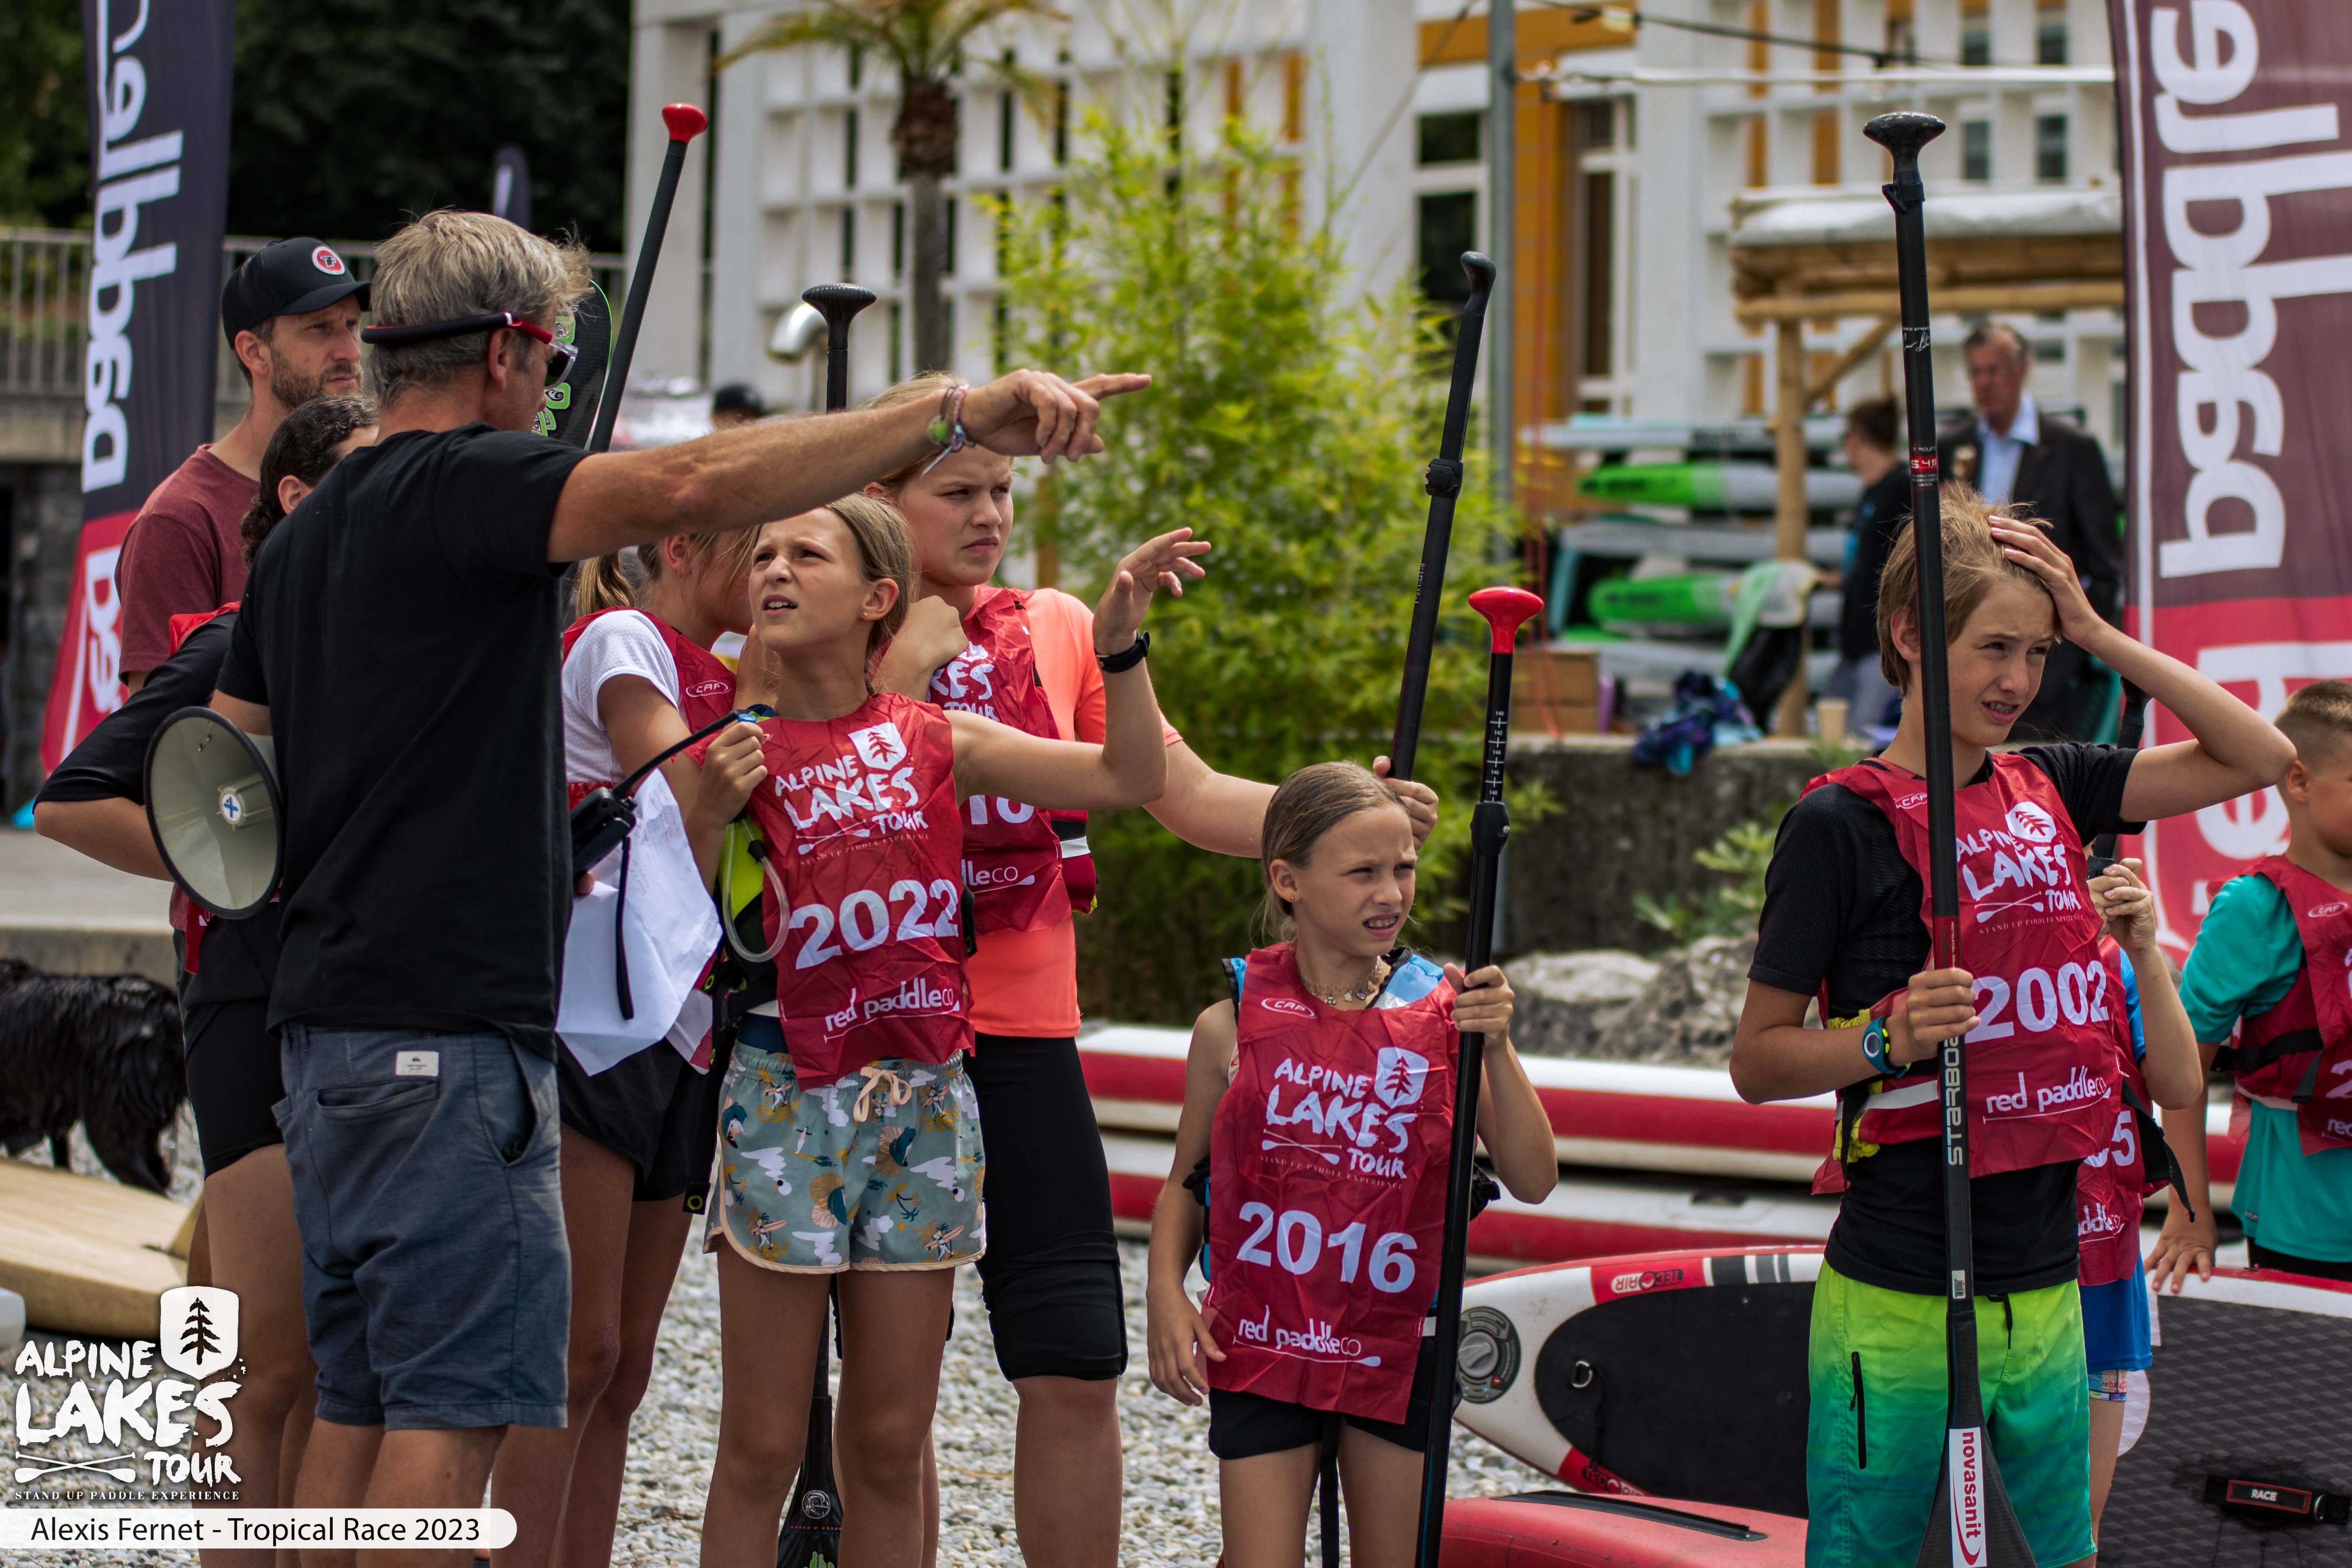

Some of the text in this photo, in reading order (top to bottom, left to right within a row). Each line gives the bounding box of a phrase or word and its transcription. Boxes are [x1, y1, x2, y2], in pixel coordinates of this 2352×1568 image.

[697, 682, 721, 693] CAP
[775, 755, 859, 797] ALPINE
[783, 766, 918, 830] LAKES
[871, 810, 929, 835] TOUR
[1962, 843, 2071, 901] LAKES
[2045, 889, 2082, 913] TOUR
[789, 878, 959, 970] 2022
[825, 988, 857, 1032] red
[1274, 1000, 1306, 1015] CAP
[1965, 960, 2109, 1044] 2002
[1274, 1057, 1373, 1100] ALPINE
[1986, 1071, 2028, 1113] red
[1266, 1084, 1418, 1153] LAKES
[1347, 1147, 1407, 1179] TOUR
[1236, 1201, 1418, 1293] 2016
[1238, 1305, 1270, 1342] red
[1962, 1432, 1976, 1539] novasanit
[2251, 1489, 2277, 1503] RACE
